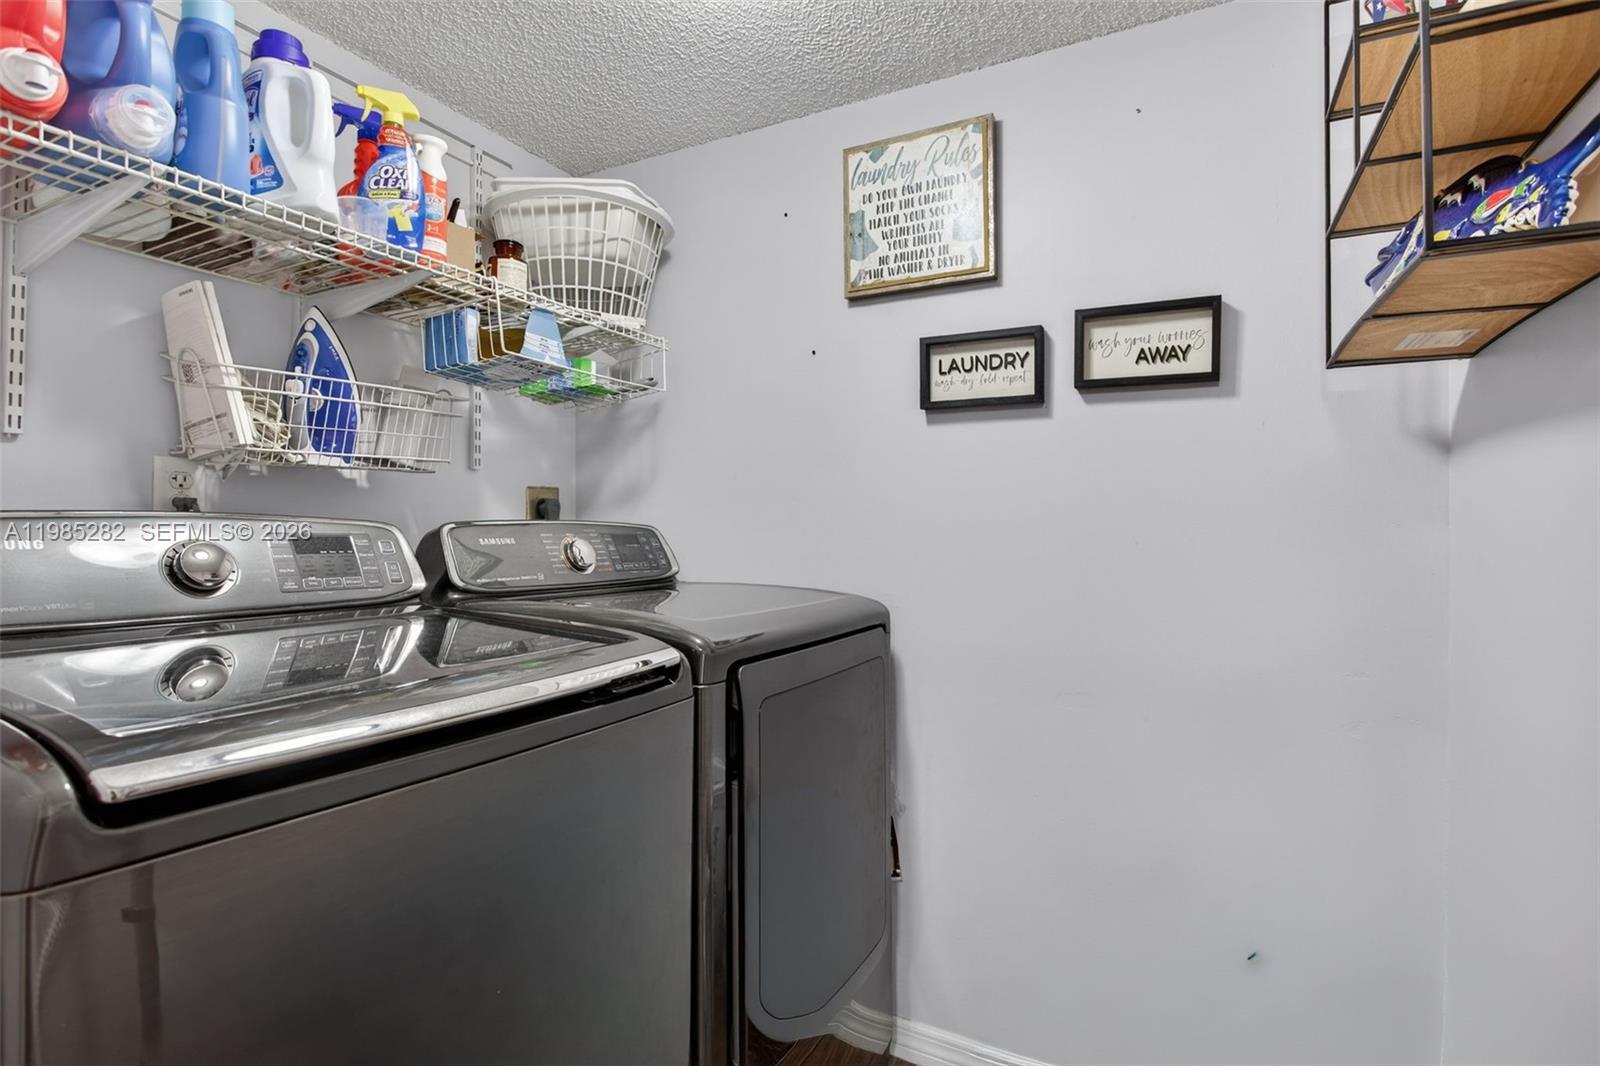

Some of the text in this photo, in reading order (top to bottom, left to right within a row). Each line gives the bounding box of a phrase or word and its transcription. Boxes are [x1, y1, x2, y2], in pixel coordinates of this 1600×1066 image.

[924, 131, 978, 178] Rules
[862, 172, 968, 205] DO YOUR OWN LAUNDRY
[875, 189, 954, 215] KEEP THE CHANGE
[868, 202, 960, 230] MATCH YOUR SOCKS
[881, 219, 945, 240] WRINKLES ARE
[887, 231, 944, 251] YOUR ENEMY
[867, 254, 966, 280] THE WASHER & DRYER
[878, 244, 950, 267] NO ANIMALS IN
[1088, 329, 1207, 359] wash your worries
[1134, 343, 1191, 365] AWAY
[938, 351, 1030, 376] LAUNDRY
[934, 370, 1031, 392] wash dry fold repeat
[0, 539, 45, 550] UNG
[479, 537, 516, 546] SAMSUNG
